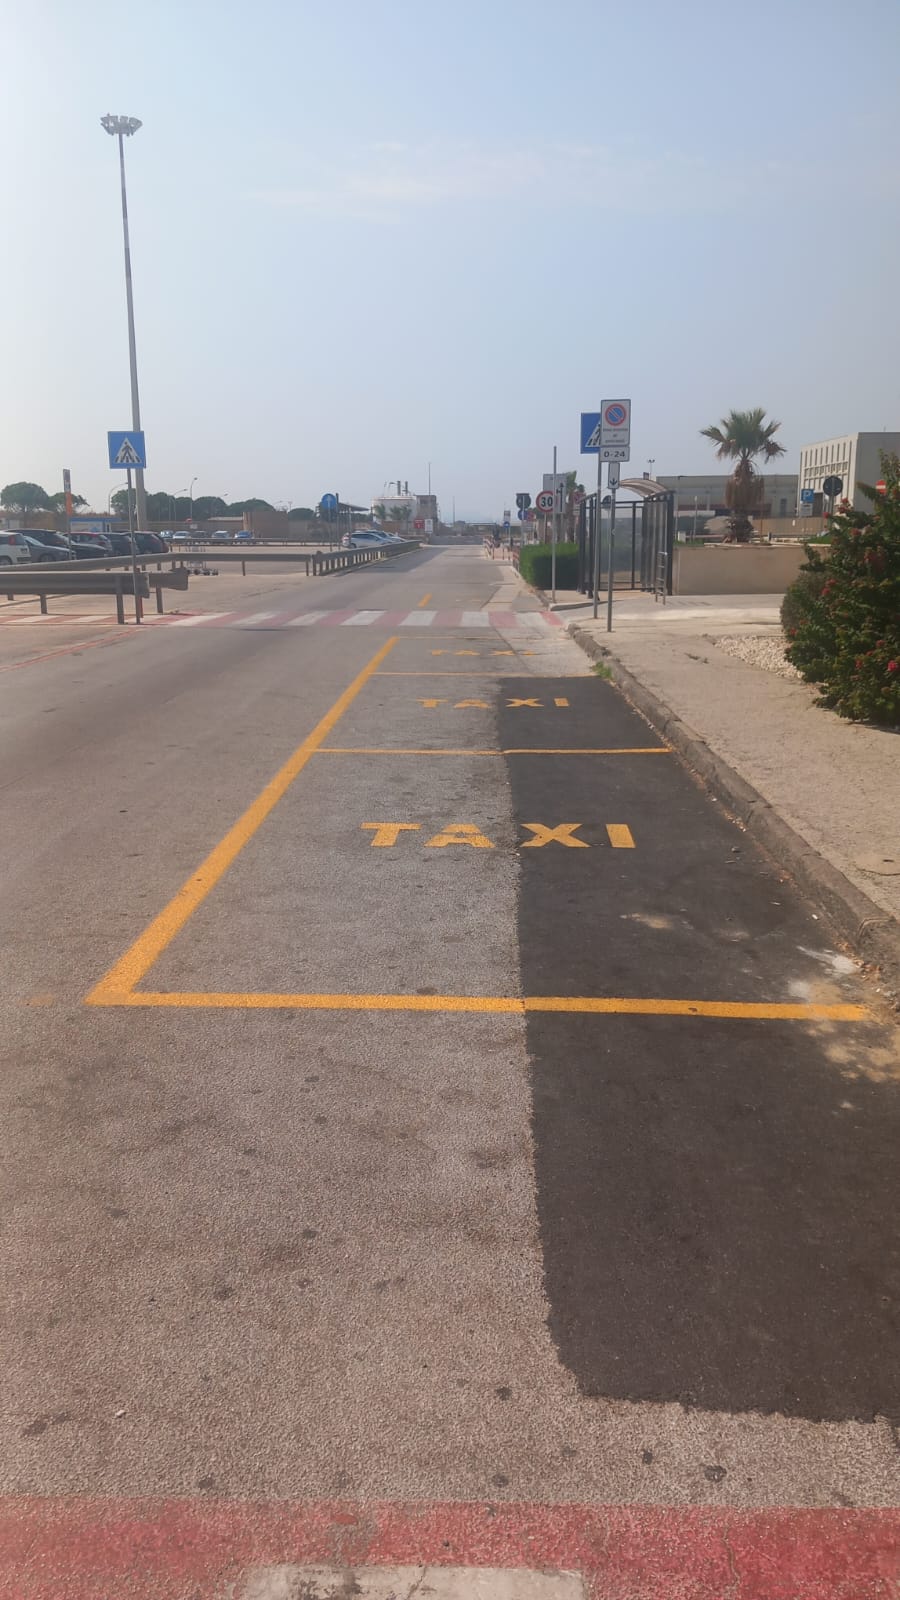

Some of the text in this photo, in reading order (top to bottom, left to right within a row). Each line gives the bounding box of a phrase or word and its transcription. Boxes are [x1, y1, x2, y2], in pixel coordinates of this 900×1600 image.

[803, 490, 812, 501] P
[541, 496, 553, 508] 30
[416, 697, 569, 708] TAXI
[360, 822, 636, 848] TAXI
